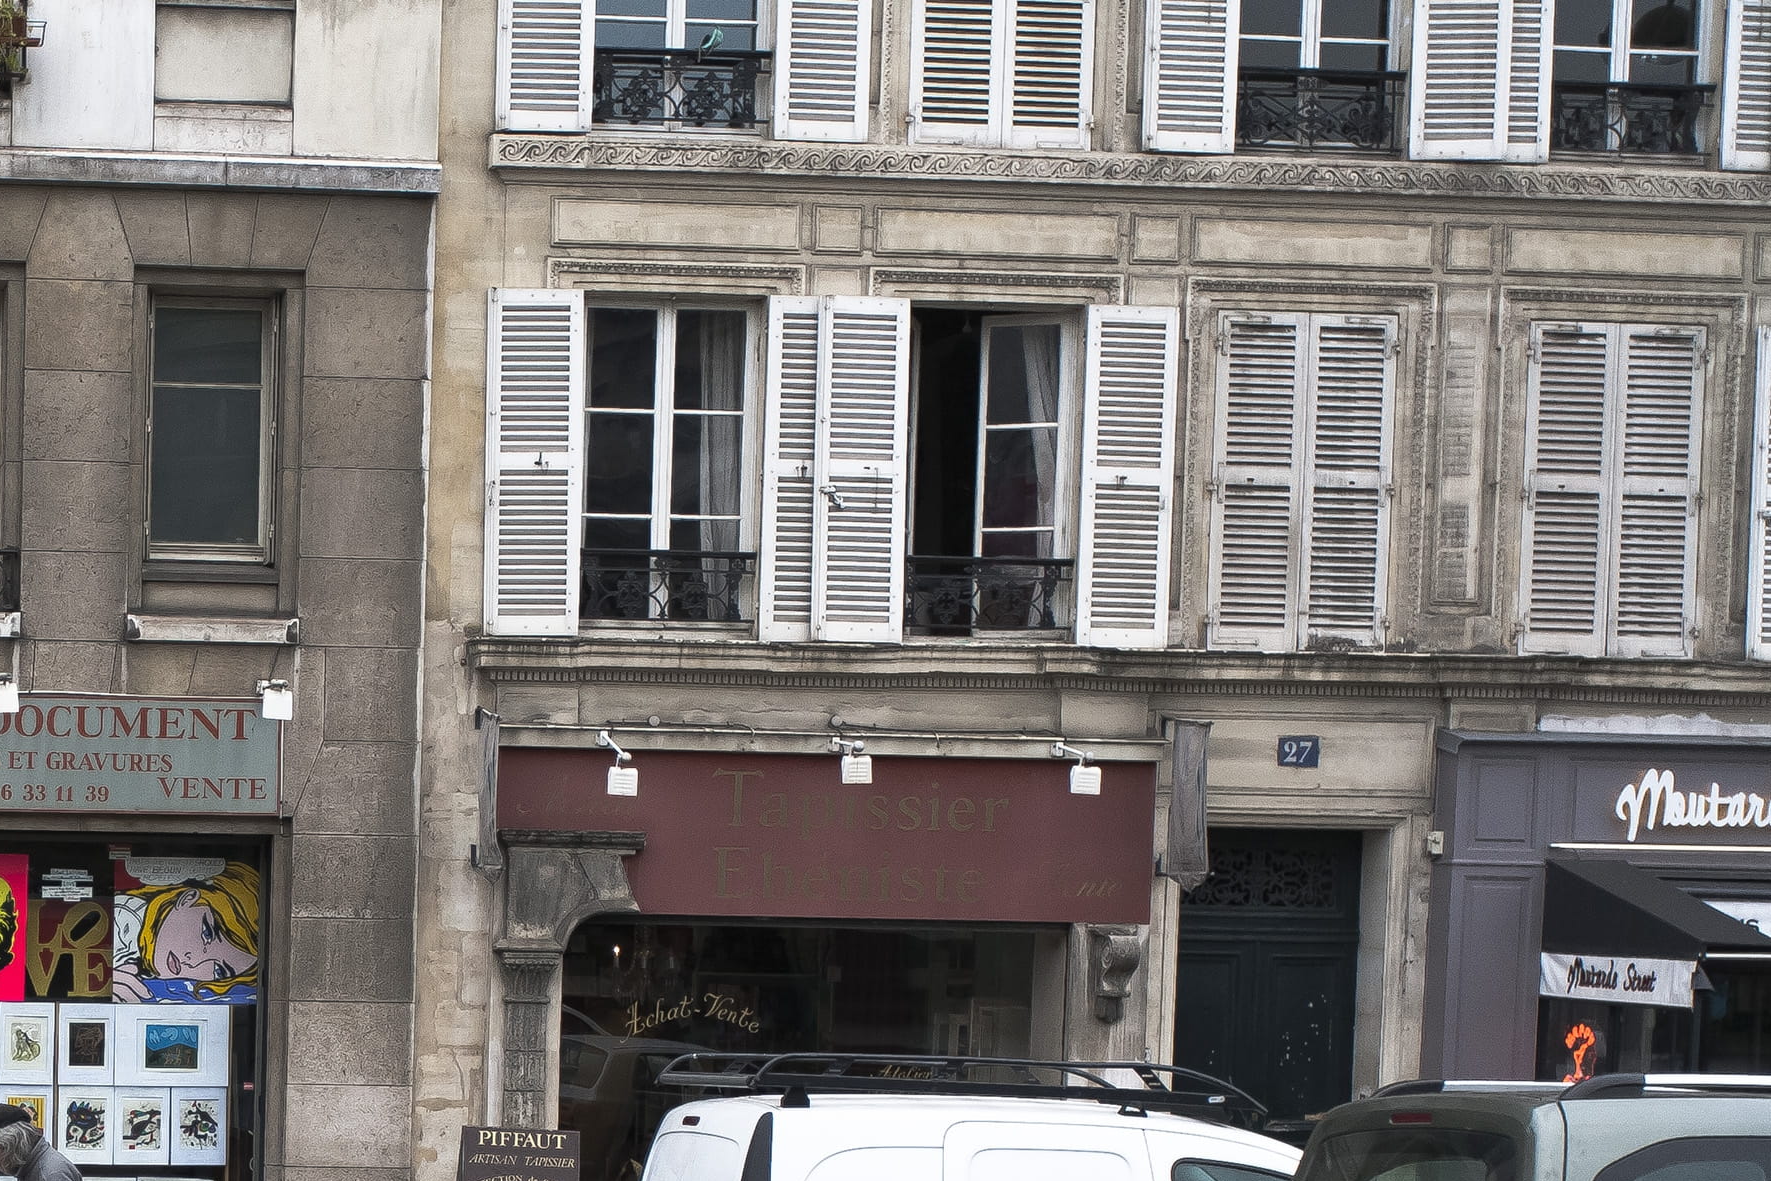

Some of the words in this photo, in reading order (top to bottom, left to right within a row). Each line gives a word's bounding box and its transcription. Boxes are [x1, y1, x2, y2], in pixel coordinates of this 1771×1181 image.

[7, 750, 38, 770] ET
[46, 751, 174, 774] GRAVURES
[1283, 740, 1313, 763] 27
[22, 783, 47, 802] 33
[54, 785, 74, 802] 11
[85, 785, 110, 802] 39
[156, 776, 268, 801] VENTE
[712, 767, 1012, 841] Tapissier
[1614, 767, 1771, 843] Moutar
[1623, 962, 1656, 992] Street
[477, 1130, 567, 1150] PIFFAUT
[468, 1153, 518, 1166] ARTISAN
[524, 1156, 576, 1169] TAPISSIER
